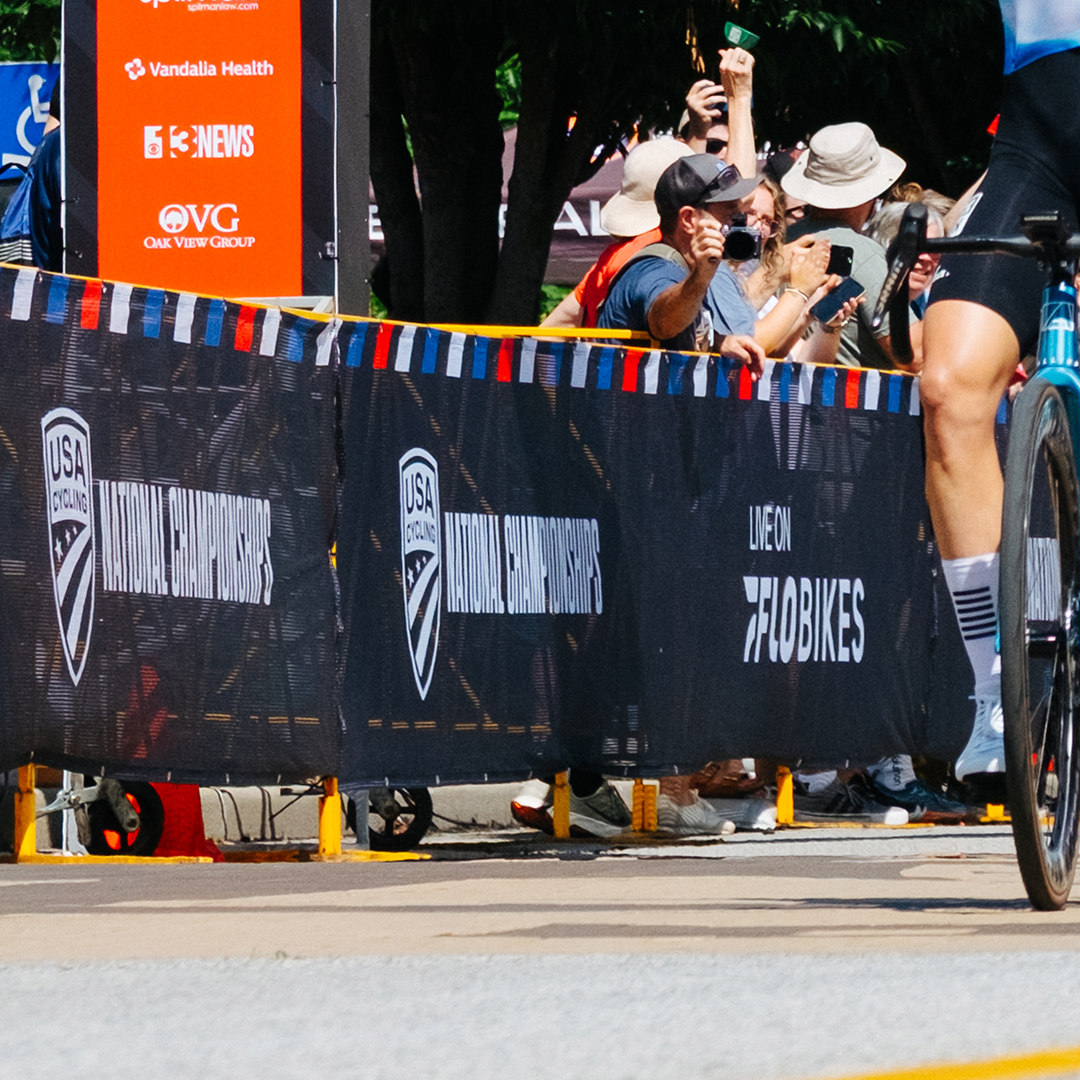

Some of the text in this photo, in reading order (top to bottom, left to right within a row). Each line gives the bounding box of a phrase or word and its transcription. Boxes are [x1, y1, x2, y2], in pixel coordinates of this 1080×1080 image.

[187, 3, 259, 12] spilmanlaw.com
[149, 59, 274, 77] Vandalia Health
[197, 124, 255, 159] NEWS
[158, 203, 240, 234] OVG
[143, 235, 256, 249] OAK VIEW GROUP
[50, 434, 86, 487] USA
[53, 488, 87, 514] CYCLING
[405, 472, 434, 519] USA
[99, 479, 274, 606] NATIONAL CHAMPIONSHIPS
[406, 521, 436, 545] CYCLING
[749, 505, 791, 551] LIVE ON
[444, 511, 603, 614] NATIONAL CHAMPIONSHIPS
[753, 575, 866, 663] FLOBIKES
